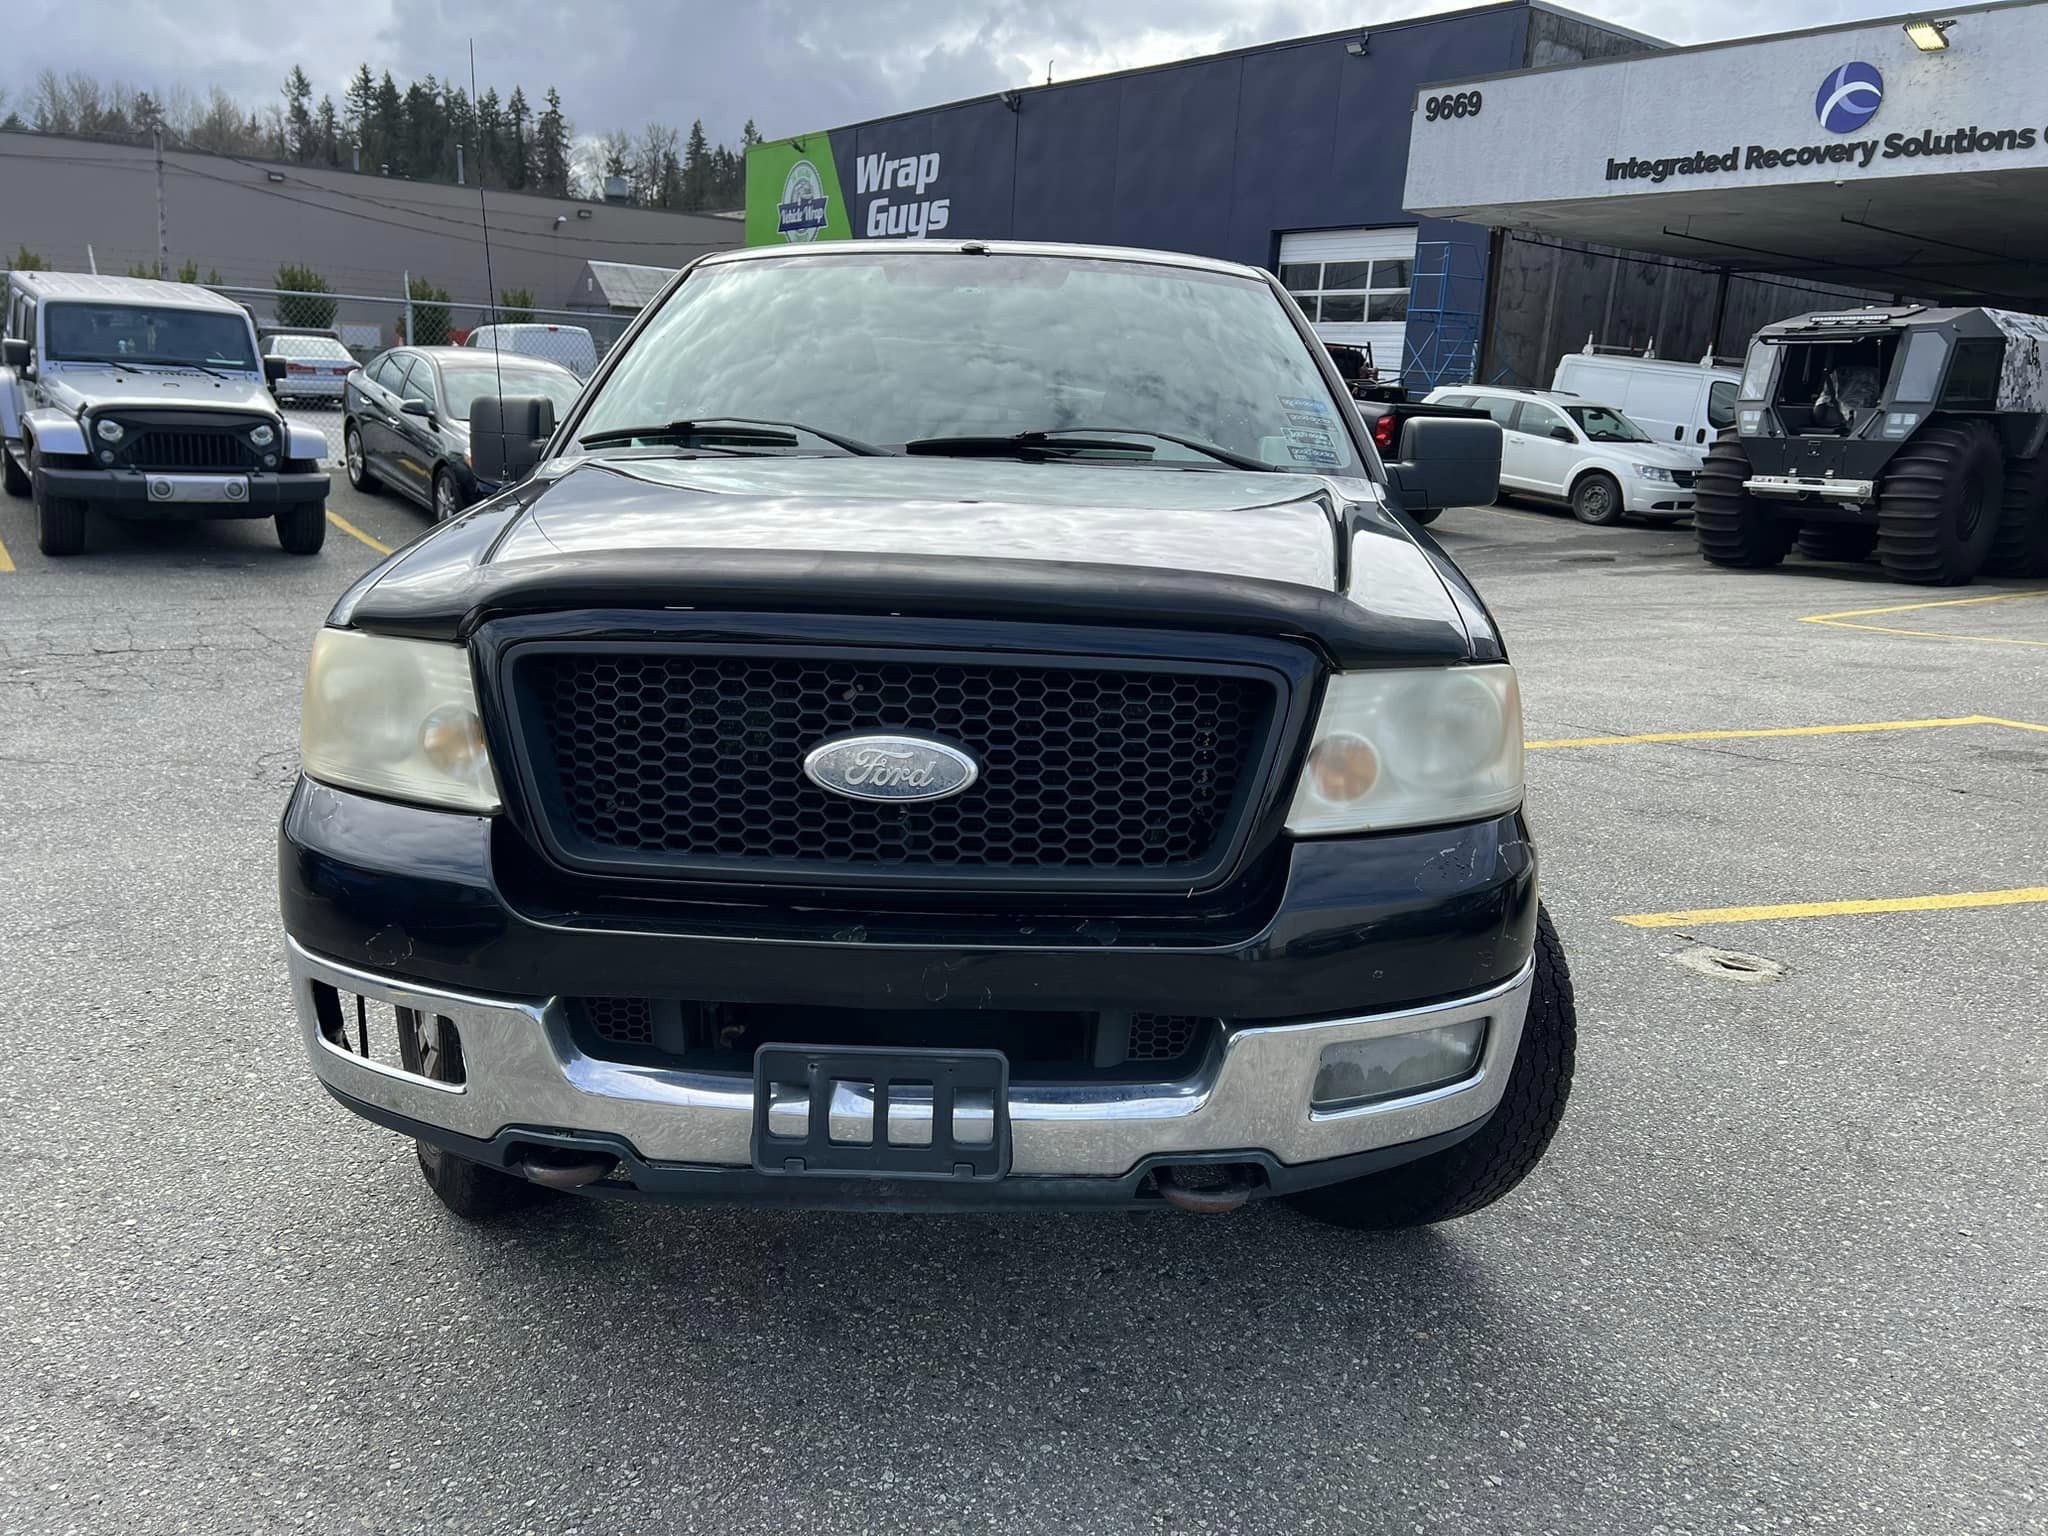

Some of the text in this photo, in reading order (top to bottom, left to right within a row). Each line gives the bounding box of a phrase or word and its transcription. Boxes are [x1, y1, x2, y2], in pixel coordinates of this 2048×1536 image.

[1425, 90, 1482, 122] 9669
[856, 151, 941, 195] Wrap
[1605, 146, 1740, 183] Integrated
[1745, 139, 1879, 168] Recovery
[1882, 126, 2037, 159] Solutions
[866, 198, 950, 240] Guys
[845, 748, 936, 787] Ford
